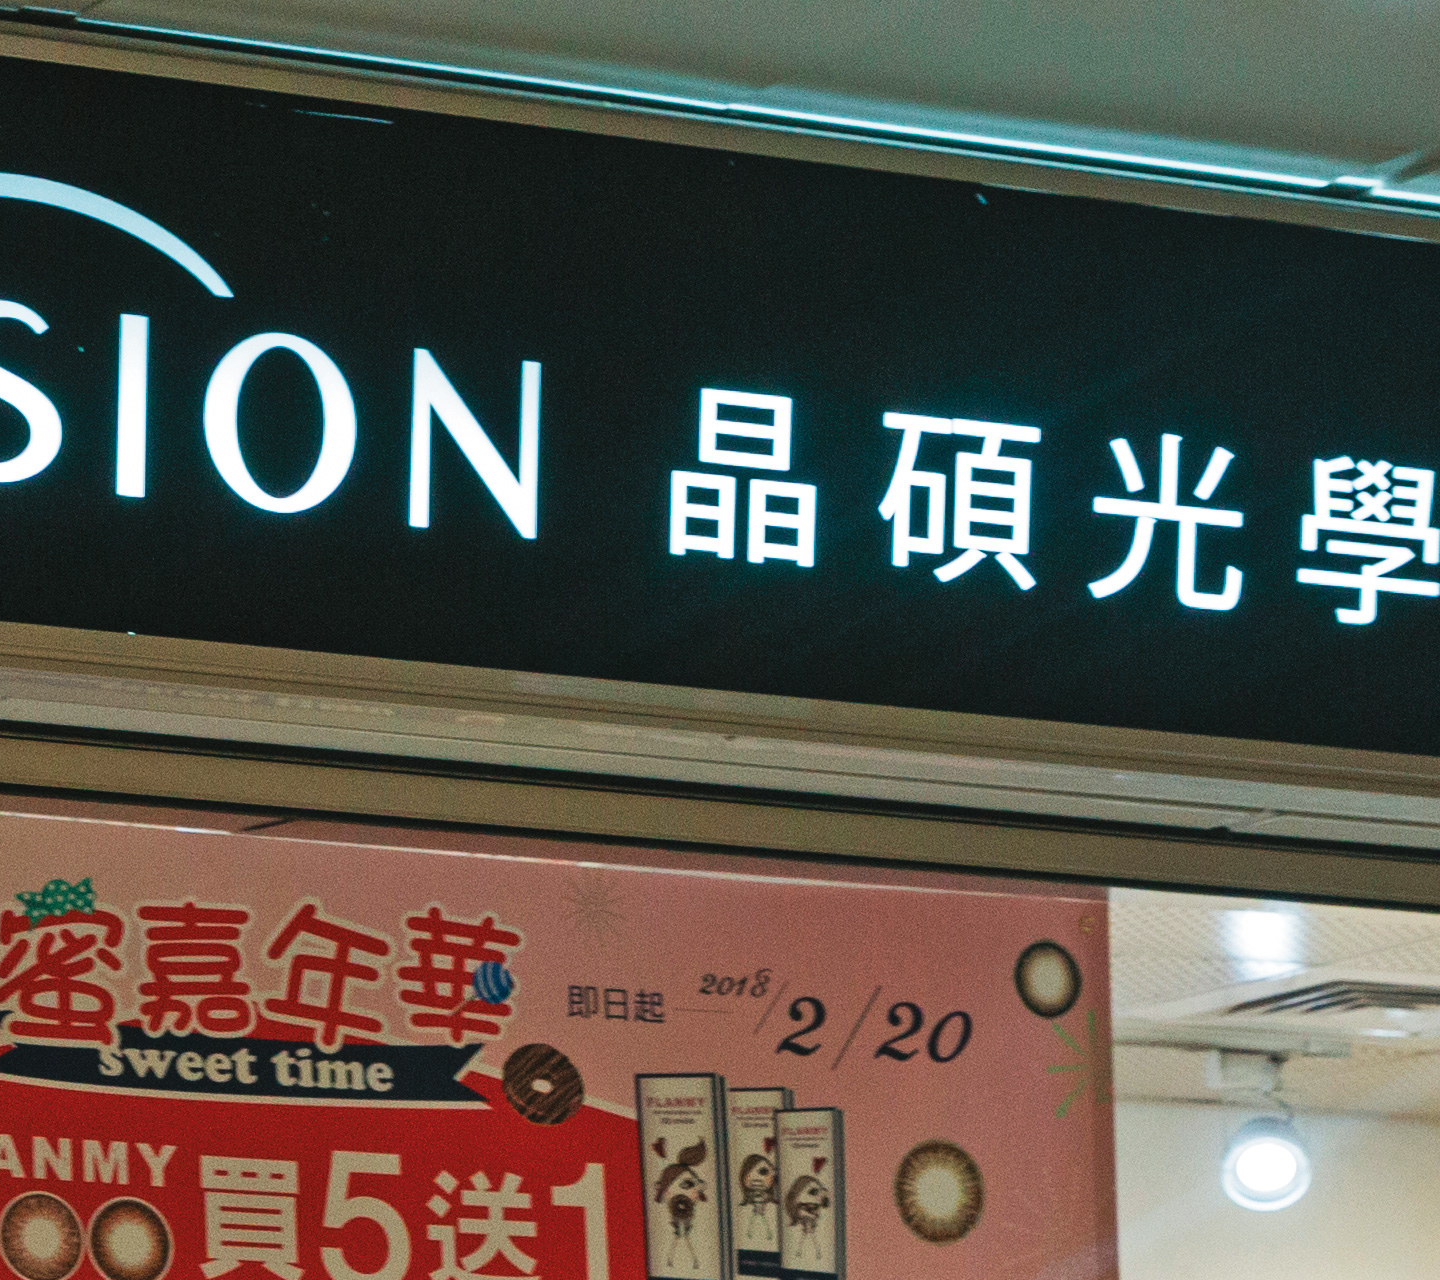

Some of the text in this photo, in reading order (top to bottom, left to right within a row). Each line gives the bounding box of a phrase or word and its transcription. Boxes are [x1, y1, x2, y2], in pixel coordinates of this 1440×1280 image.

[567, 985, 665, 1023] 即日起
[98, 1045, 394, 1092] sweet time
